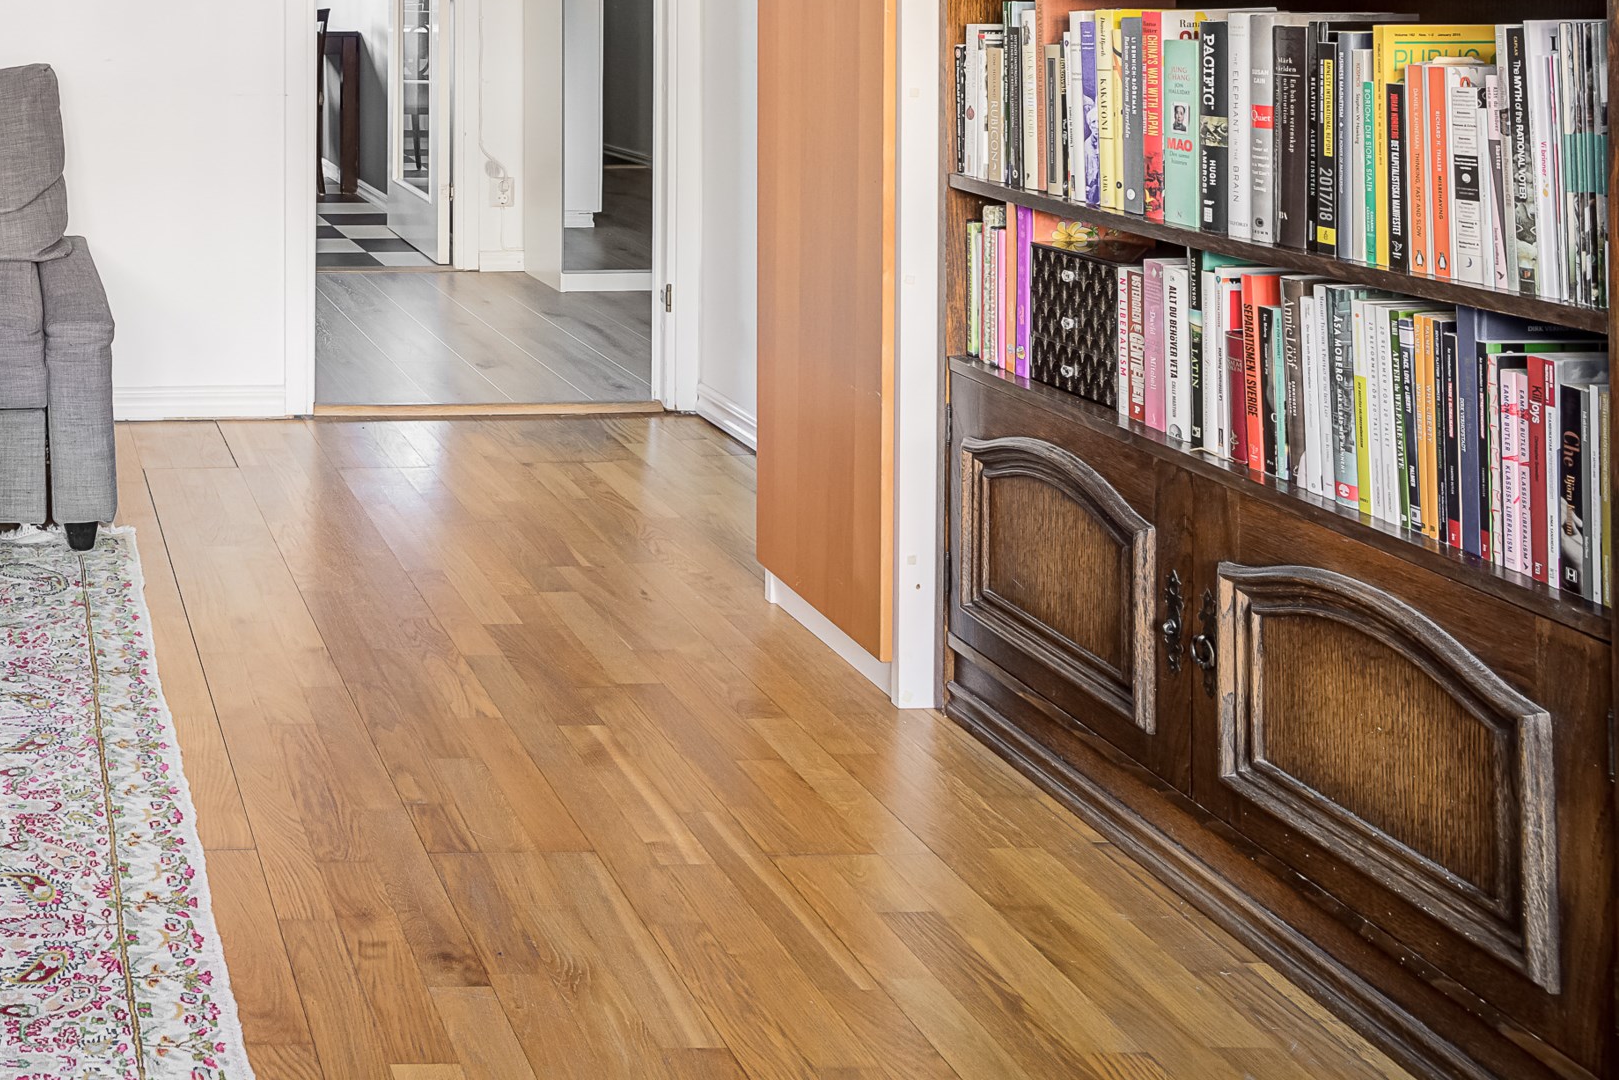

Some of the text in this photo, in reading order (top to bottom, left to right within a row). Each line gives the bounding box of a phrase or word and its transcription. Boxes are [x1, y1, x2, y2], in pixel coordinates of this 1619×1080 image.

[1147, 34, 1159, 136] CHINA'S WAR WITH JAPAN
[1203, 33, 1215, 105] PACIFIC
[1289, 79, 1296, 88] En
[1324, 62, 1332, 87] AMNESTY
[1513, 59, 1522, 75] The
[1514, 75, 1522, 102] MYTH
[1027, 73, 1035, 138] WEATHERFORD
[1100, 78, 1108, 130] KAKAFONI
[1251, 109, 1272, 124] Quiet
[1289, 105, 1295, 115] om
[1324, 88, 1332, 131] INTERNATIONAL
[1515, 111, 1523, 123] the
[990, 100, 999, 162] RUBICON
[1167, 137, 1192, 152] MAO
[1232, 70, 1240, 202] ELEPHANT BRAIN
[1288, 117, 1296, 153] vetenskap
[1516, 123, 1525, 167] RATIONAL
[1390, 93, 1401, 236] JOHAN NORBERG DET KAPITALISTISKA MANIFESTET
[1540, 140, 1548, 177] Vi brinner
[1319, 167, 1333, 221] 2017/18
[1518, 169, 1526, 199] VOTER
[1120, 277, 1128, 377] NY LIBERALISM
[1168, 285, 1178, 379] ALLT DU VETA
[1283, 297, 1298, 370] Annie Lööf
[1333, 315, 1344, 381] ÅSA MOBERG
[1129, 332, 1145, 405] GENTLEMEN
[1191, 348, 1199, 389] LATIN
[1244, 303, 1258, 418] SEPARATISMEN SVERIGE
[1380, 340, 1388, 384] REFORMER
[1392, 349, 1405, 470] AFTER WELFARE STATE
[1425, 384, 1433, 404] WHY
[1503, 384, 1511, 420] EAMONN
[1519, 389, 1527, 425] EAMONN
[1530, 384, 1542, 424] Killjoys
[1505, 465, 1513, 503] KLASSISK
[1563, 430, 1580, 501] Che Björn
[1520, 471, 1528, 510] KLASSISK
[1506, 505, 1514, 553] LIBERALISM
[1521, 512, 1529, 560] LIBERALISM
